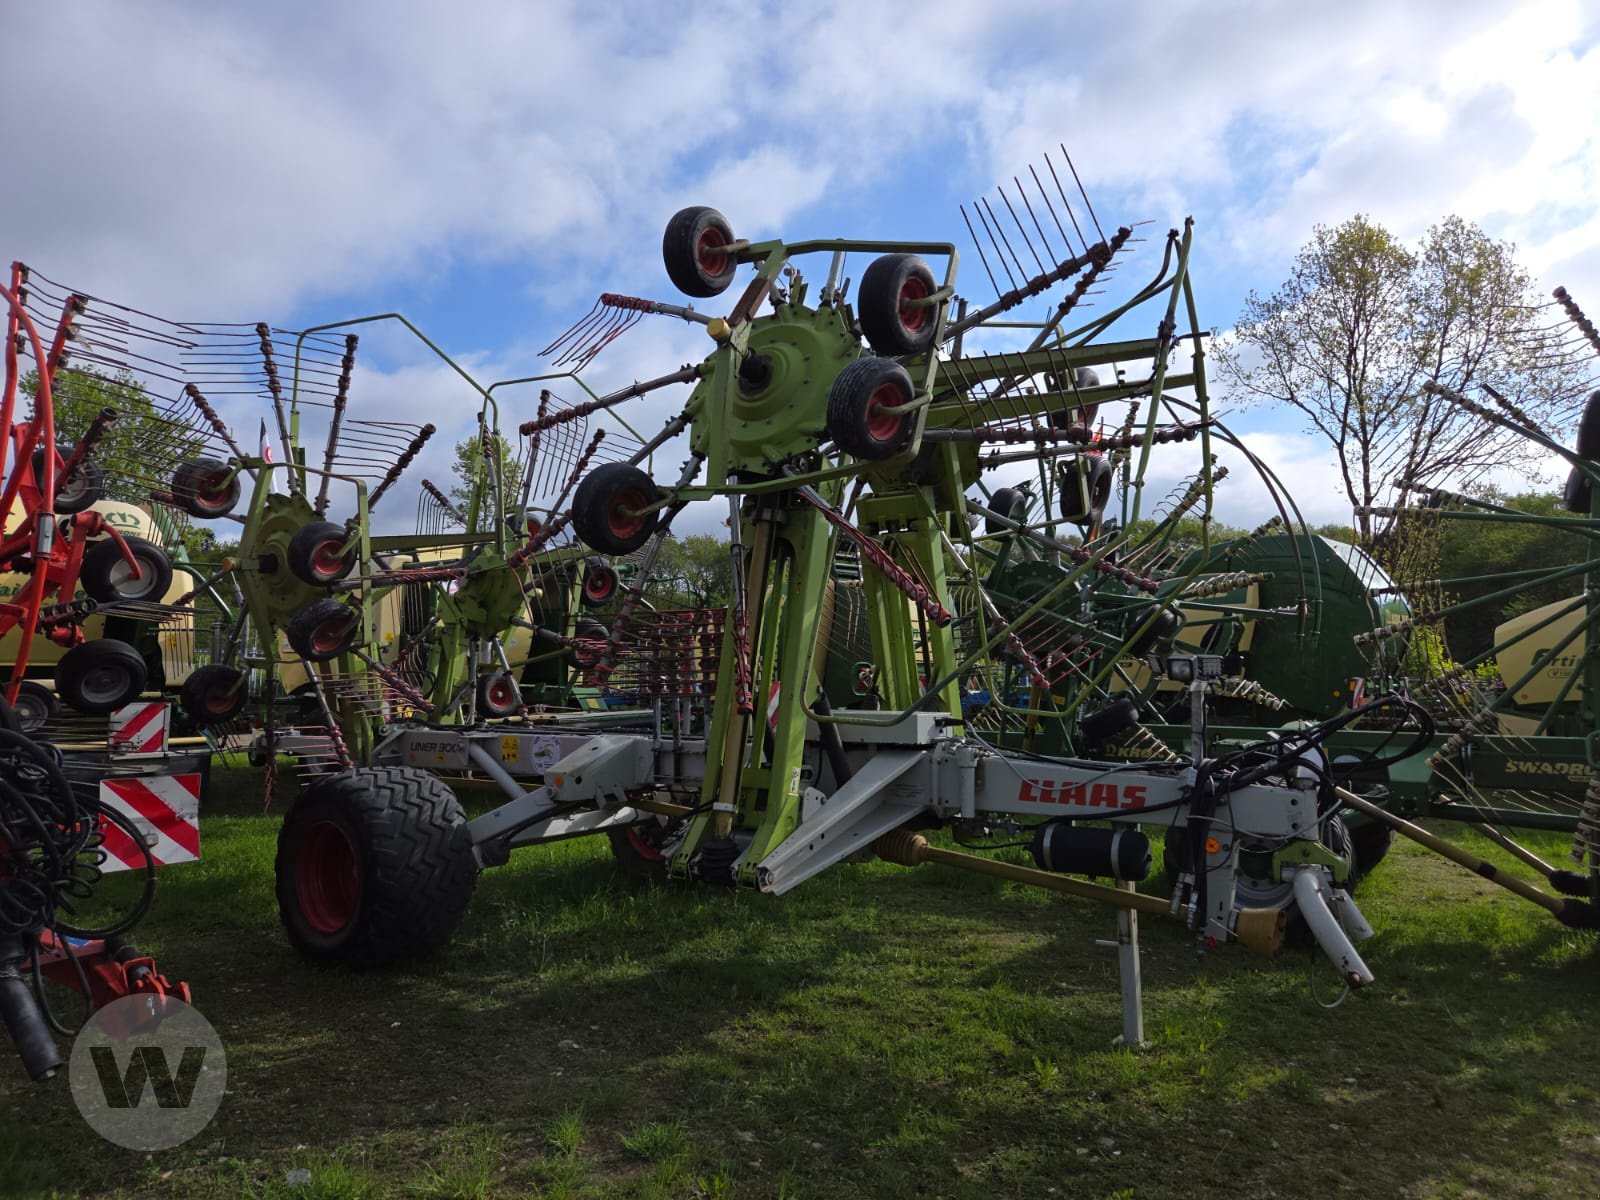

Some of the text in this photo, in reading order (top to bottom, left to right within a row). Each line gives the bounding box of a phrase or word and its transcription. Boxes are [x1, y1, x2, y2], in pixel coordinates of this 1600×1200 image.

[410, 741, 437, 752] LINER
[1117, 745, 1165, 759] KRO
[1018, 778, 1148, 810] CLAAS
